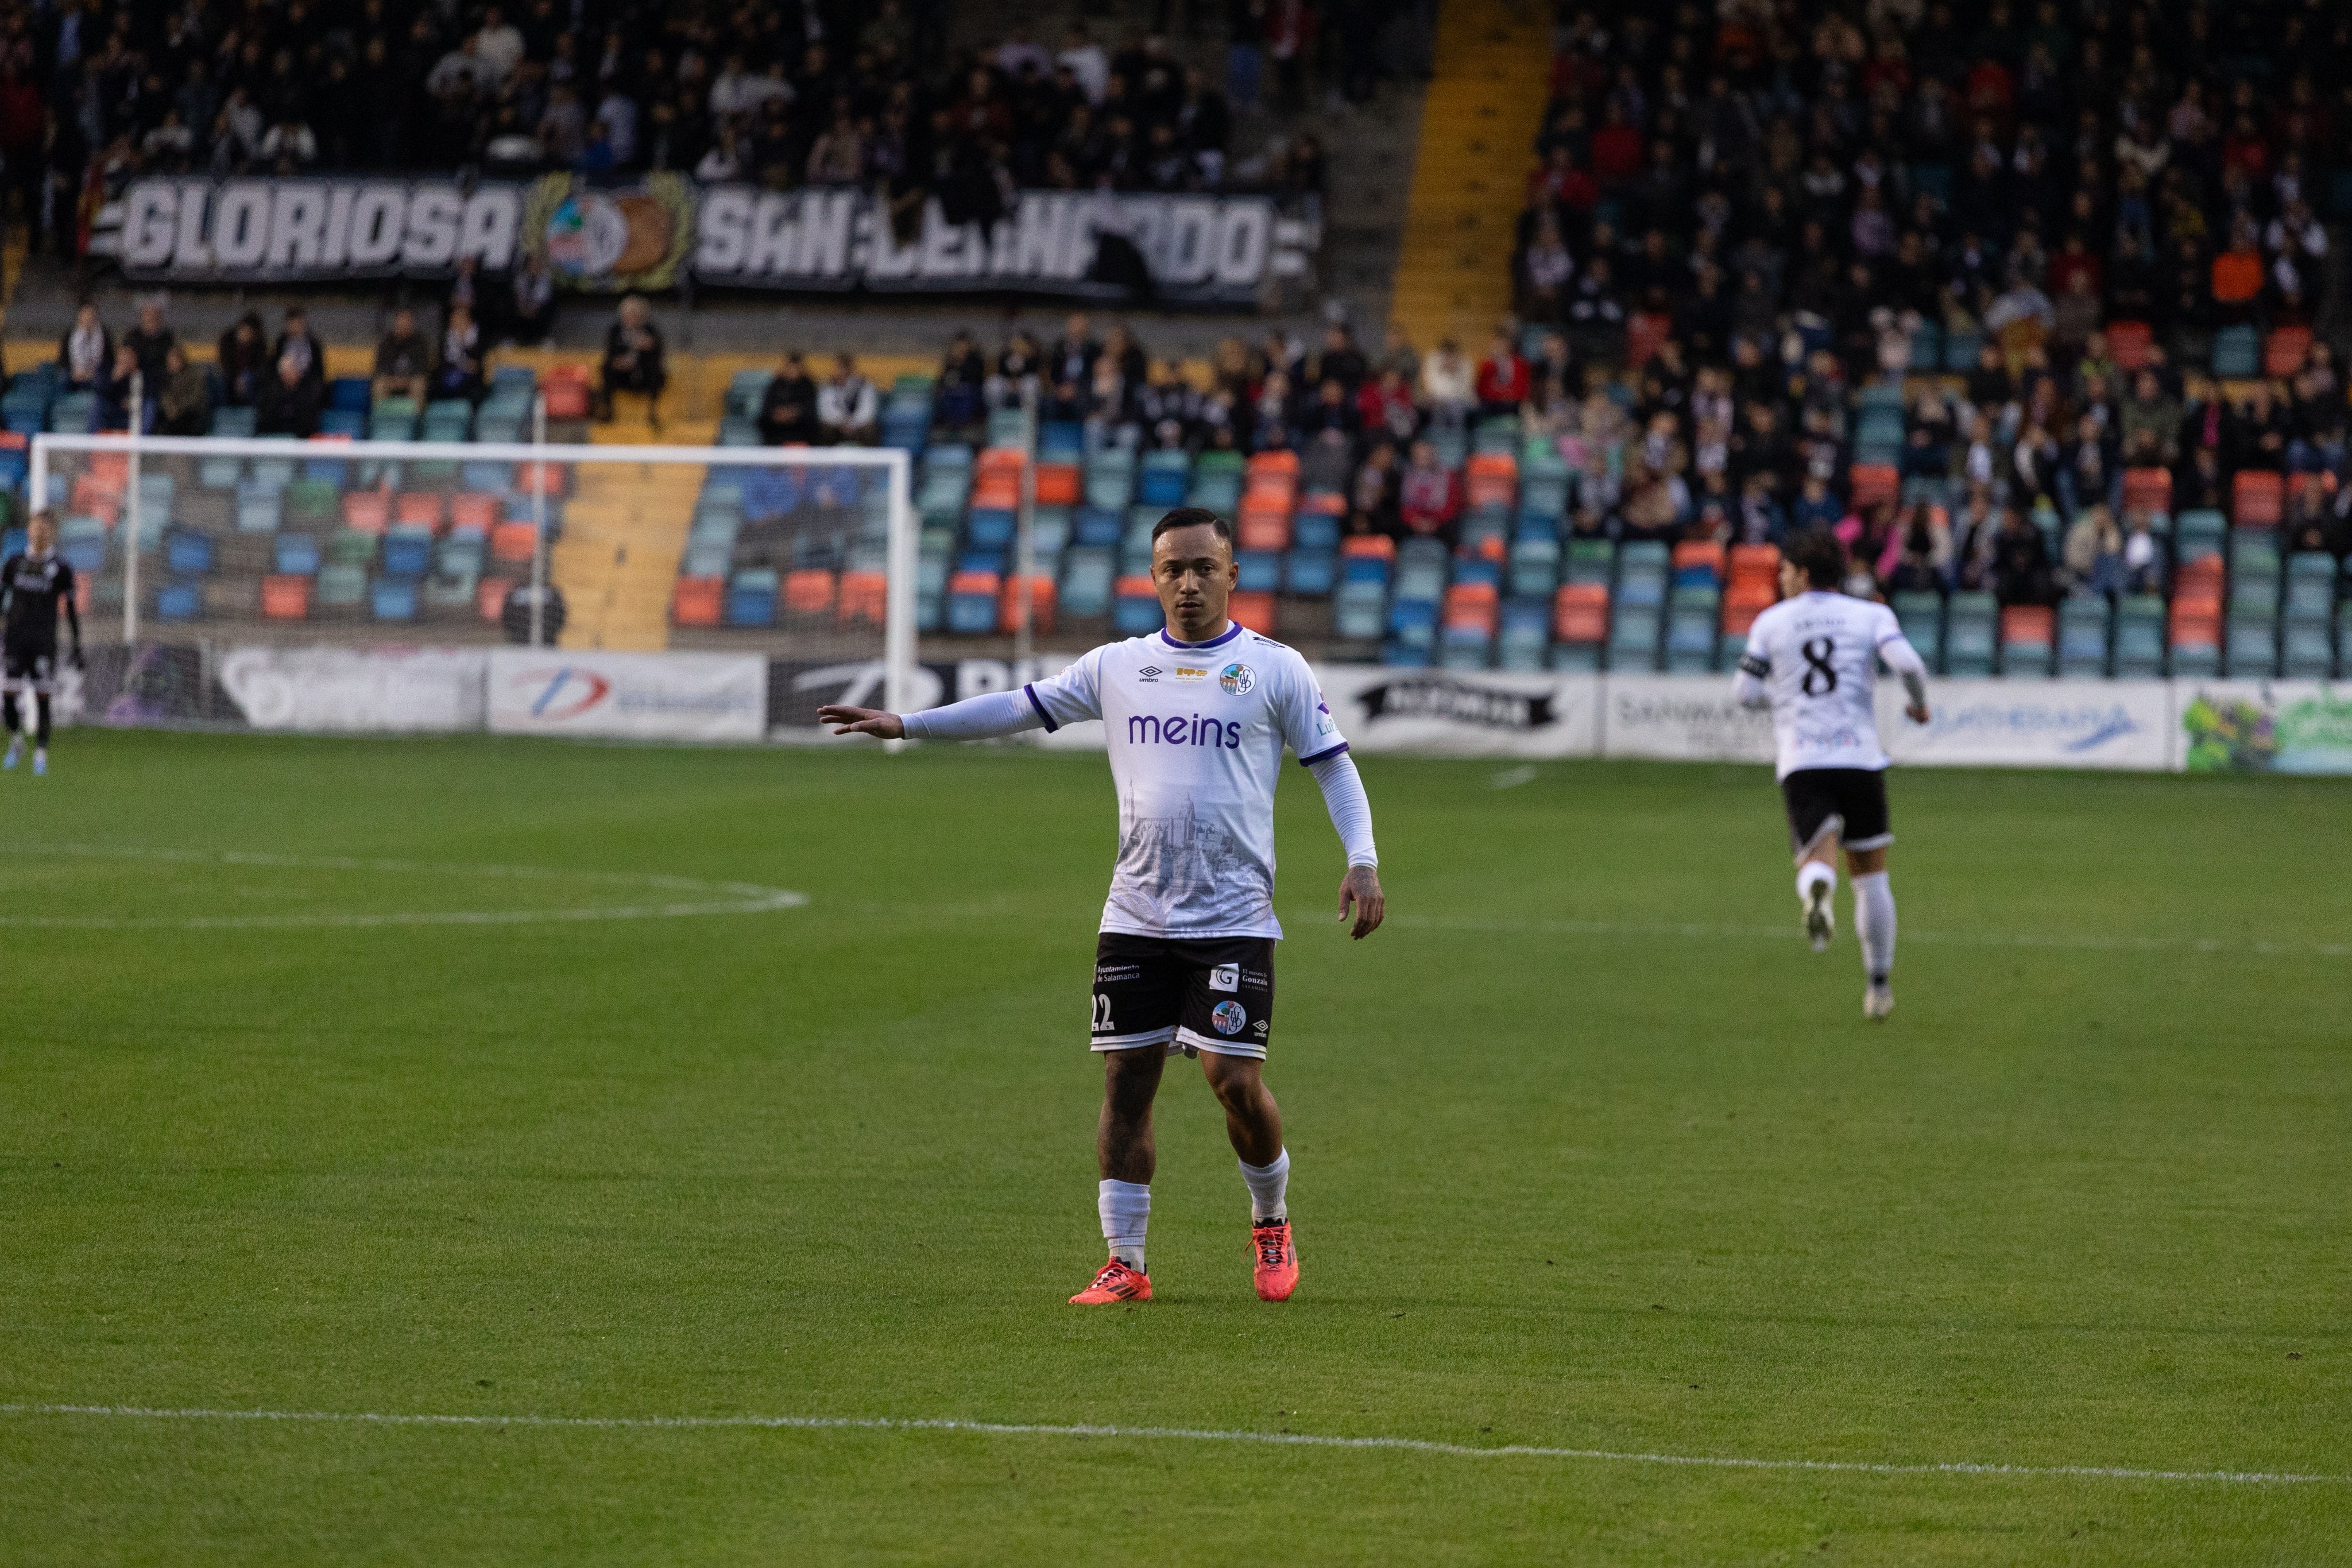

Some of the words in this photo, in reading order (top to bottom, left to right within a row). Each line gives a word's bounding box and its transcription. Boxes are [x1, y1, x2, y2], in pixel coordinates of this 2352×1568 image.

[122, 181, 523, 269] GLORIOSA
[1801, 636, 1838, 697] 8
[1128, 713, 1241, 749] meins
[1097, 965, 1140, 974] Ayuntamiento
[1104, 973, 1140, 982] Salamanca
[1091, 993, 1115, 1031] 22
